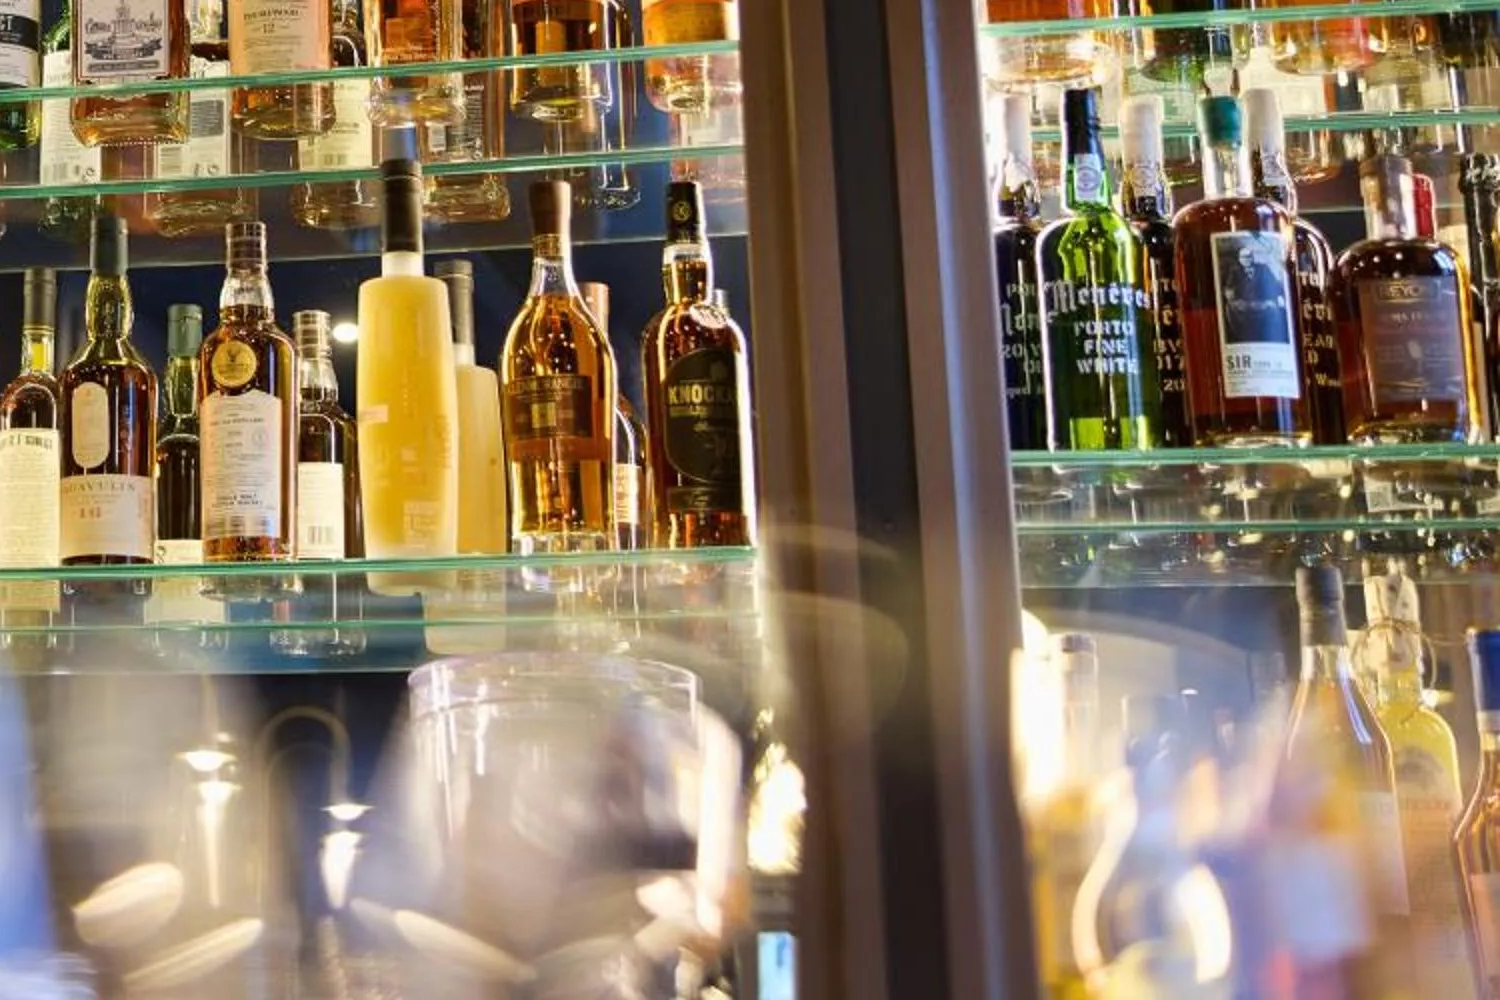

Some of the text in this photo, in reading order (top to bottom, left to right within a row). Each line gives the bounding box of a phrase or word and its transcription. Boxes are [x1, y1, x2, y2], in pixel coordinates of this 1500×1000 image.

[1073, 320, 1133, 337] PORTO
[1084, 340, 1129, 355] FINE
[1076, 357, 1139, 374] WHITE
[1226, 354, 1251, 371] SIR
